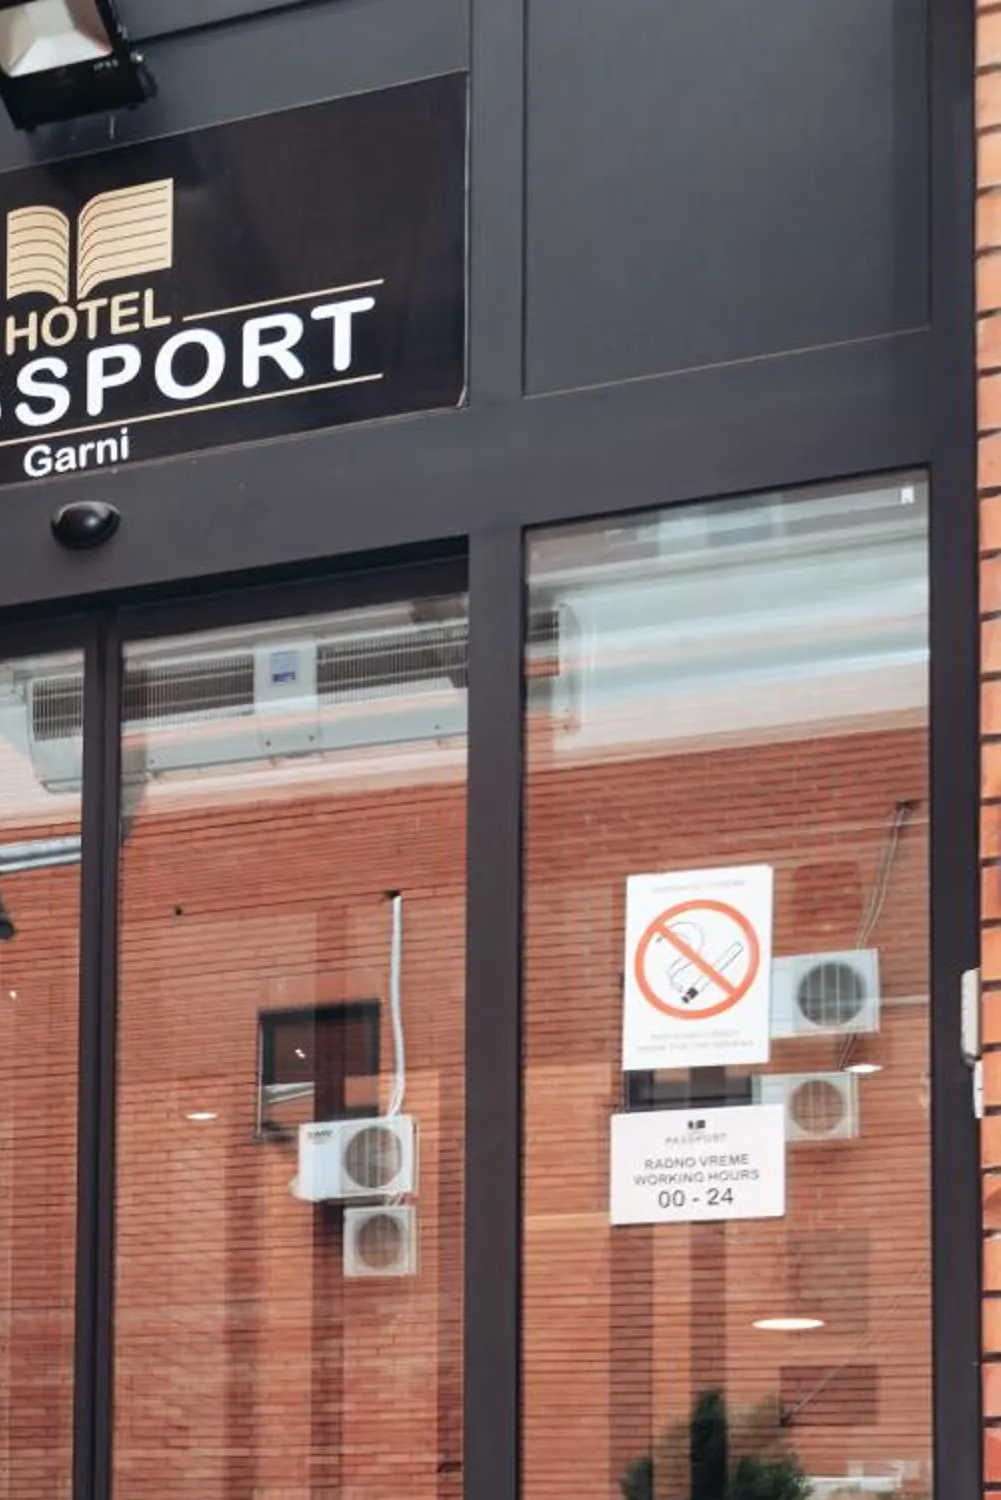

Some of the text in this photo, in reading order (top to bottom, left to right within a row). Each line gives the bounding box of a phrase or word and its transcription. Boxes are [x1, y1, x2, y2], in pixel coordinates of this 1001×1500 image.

[4, 288, 171, 356] HOTEL
[22, 428, 130, 478] Garni
[643, 1153, 750, 1169] RADNO VREME
[633, 1168, 760, 1185] WORKING HOURS
[657, 1188, 686, 1209] 00
[705, 1186, 736, 1207] 24
